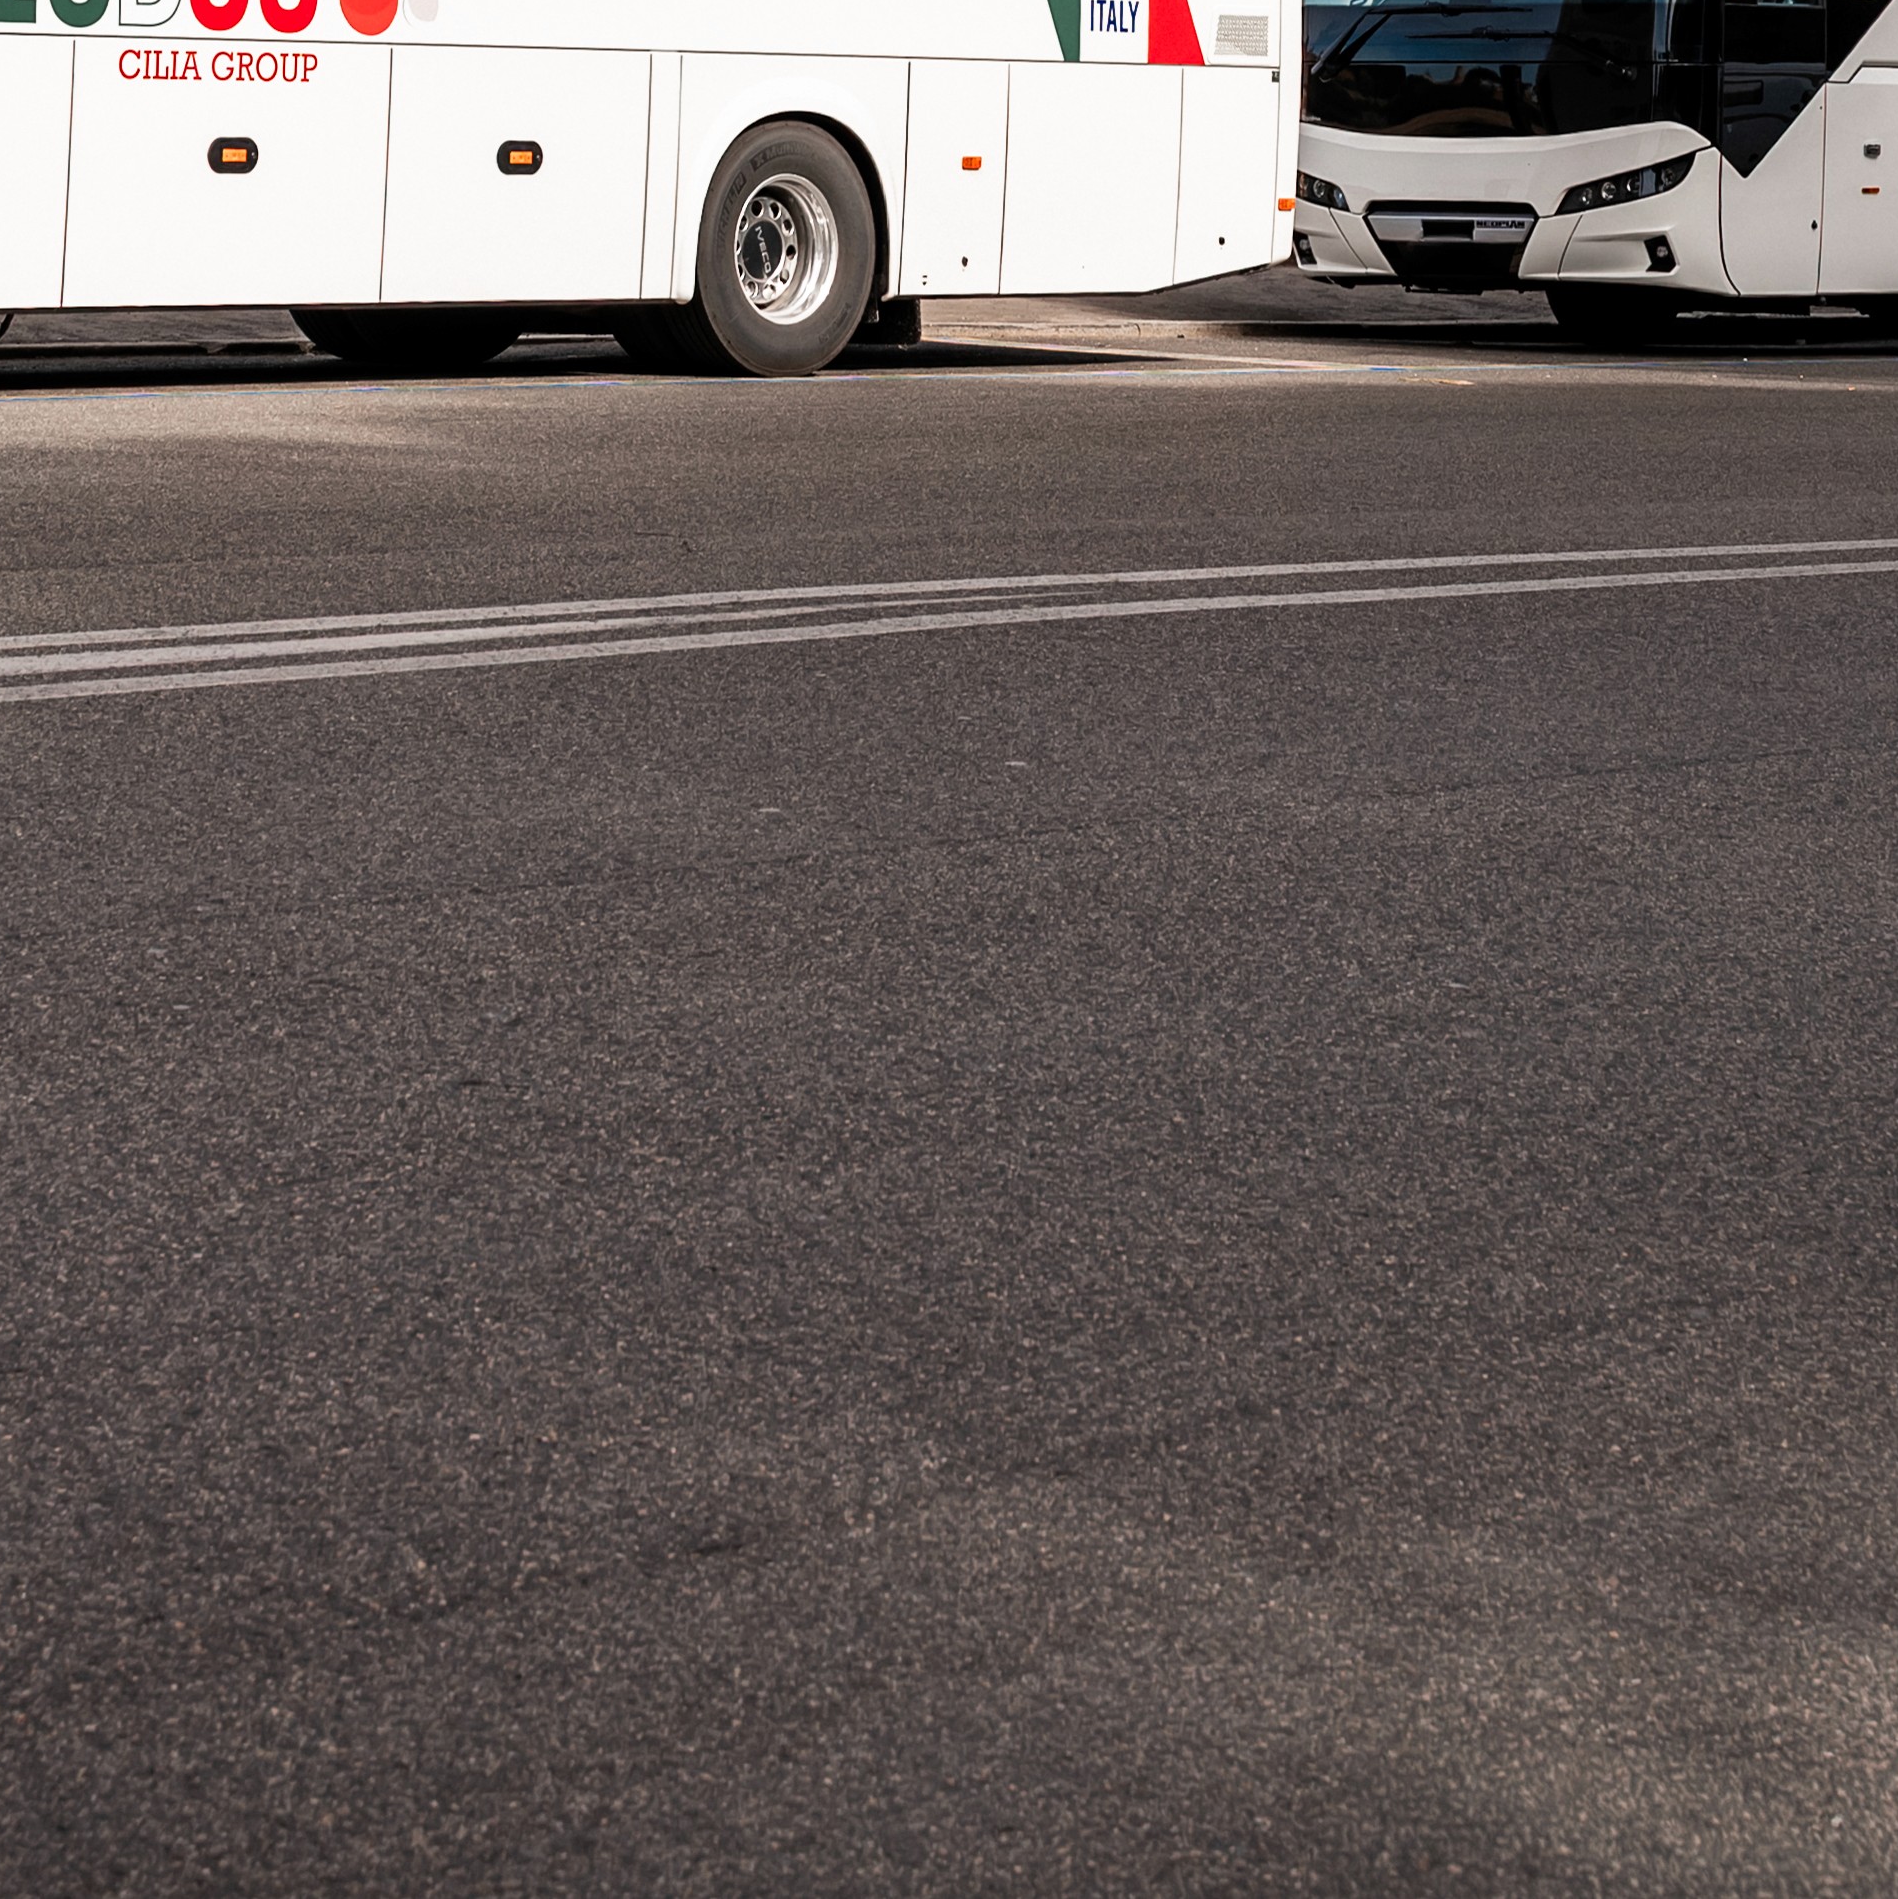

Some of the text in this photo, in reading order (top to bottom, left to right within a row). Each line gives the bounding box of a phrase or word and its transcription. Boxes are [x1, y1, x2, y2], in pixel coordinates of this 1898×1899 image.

[1090, 0, 1139, 33] ITALY
[119, 50, 318, 82] CILIA GROUP
[754, 226, 772, 273] IVECO
